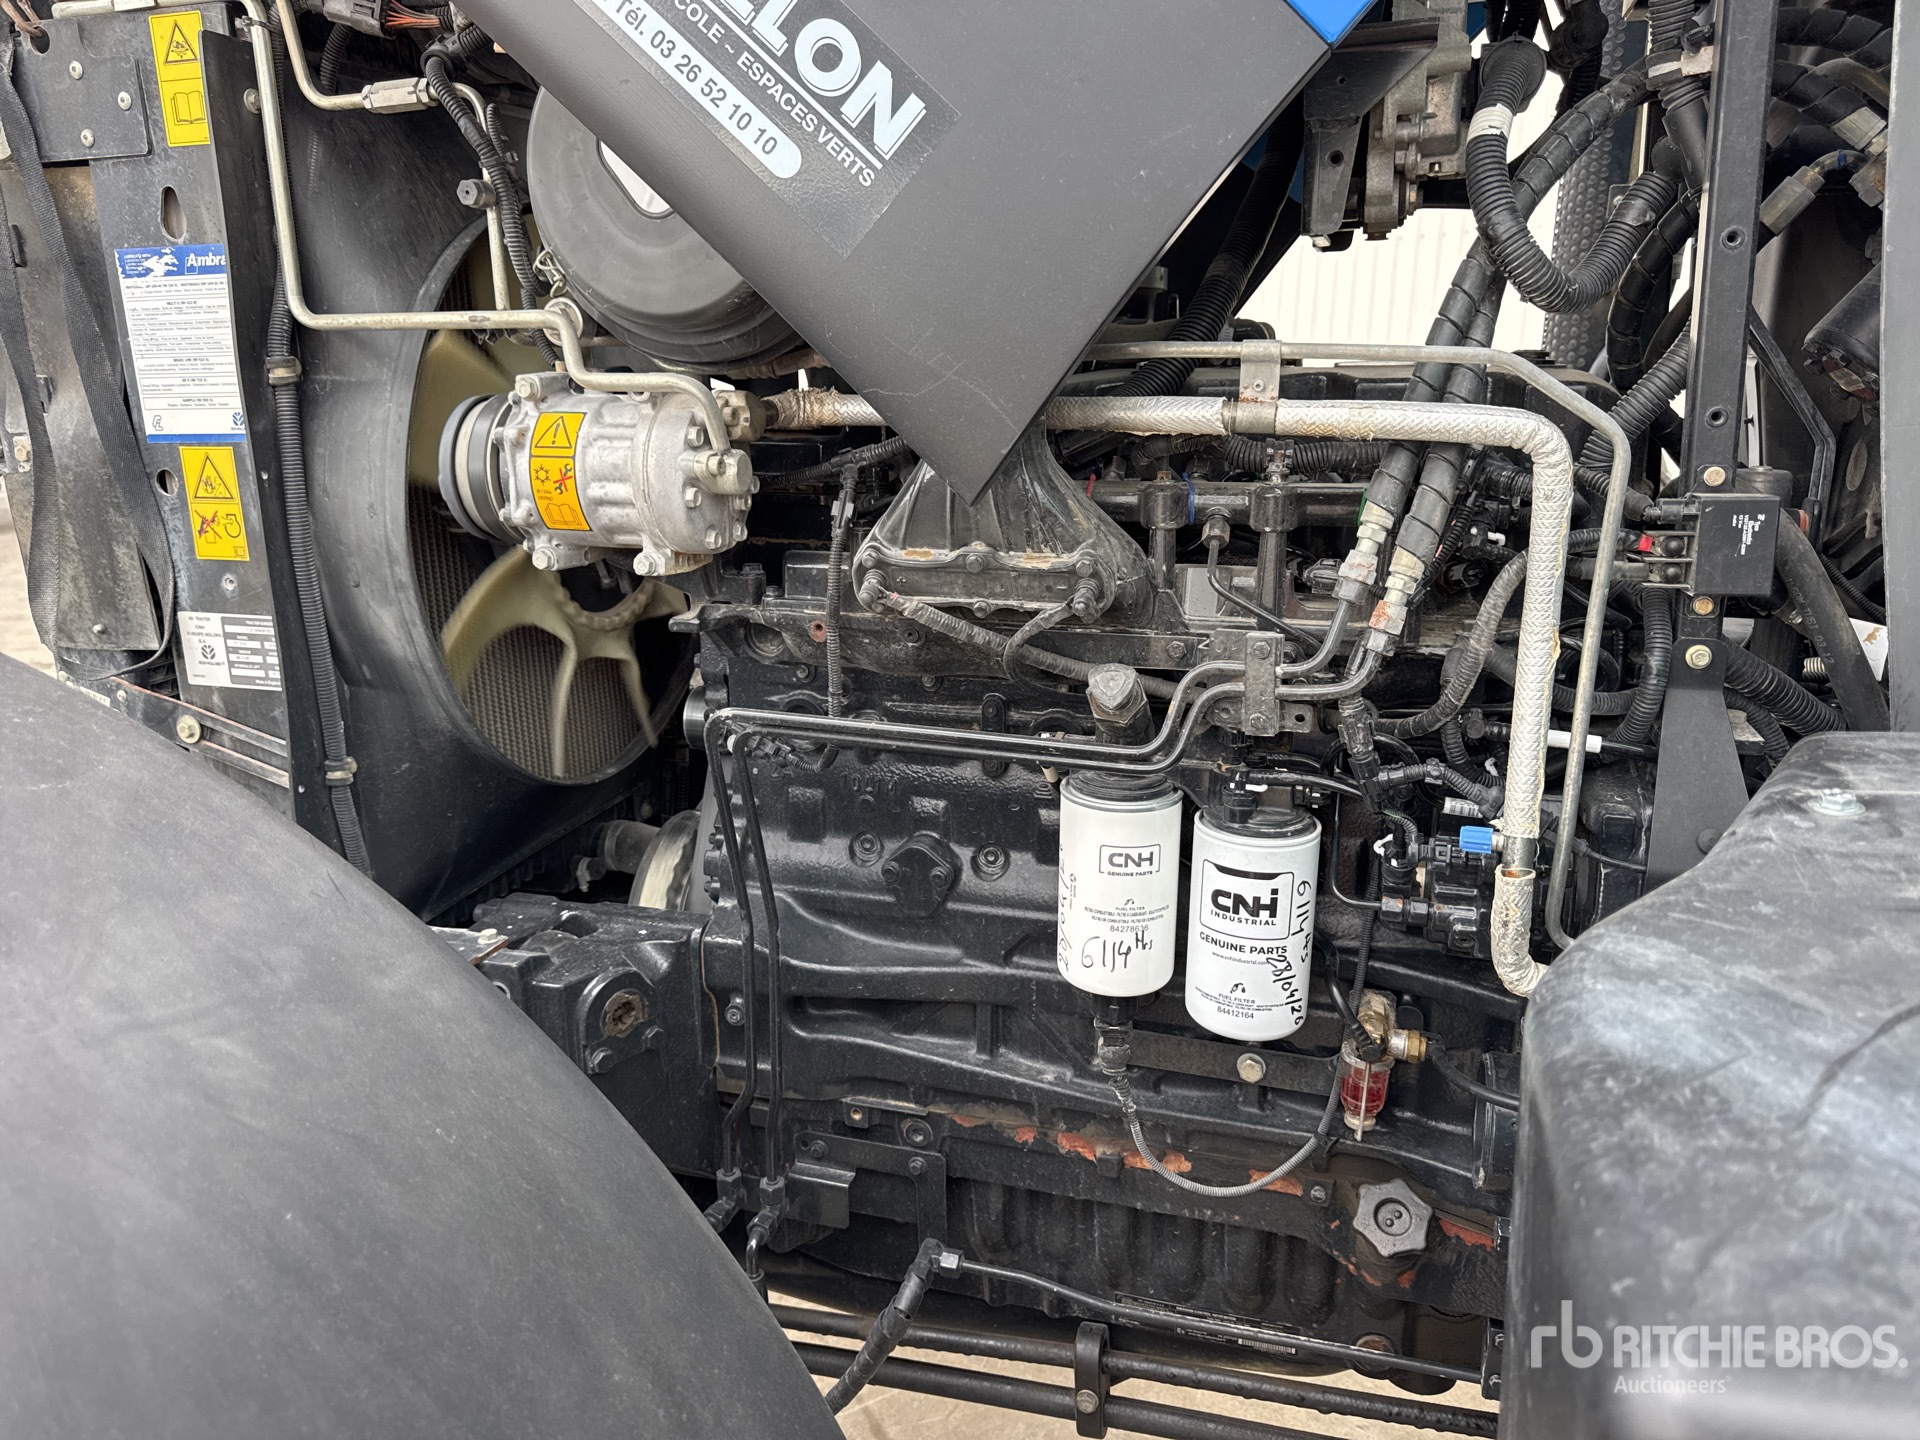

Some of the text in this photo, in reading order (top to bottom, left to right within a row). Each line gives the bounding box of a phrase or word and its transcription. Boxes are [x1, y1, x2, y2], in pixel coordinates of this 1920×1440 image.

[650, 30, 676, 59] 03
[674, 54, 702, 84] 26
[700, 75, 729, 109] 52
[727, 102, 753, 132] 10
[753, 125, 779, 156] 10
[737, 51, 818, 133] ESPACES
[816, 125, 876, 187] VERTS
[1108, 851, 1154, 868] CNH
[1210, 909, 1277, 926] INDUSTRIAL
[1199, 931, 1288, 955] GENUINE PARTS
[1218, 992, 1233, 1002] FUEL
[1233, 996, 1256, 1005] FILTER
[1216, 1006, 1255, 1019] 84412164
